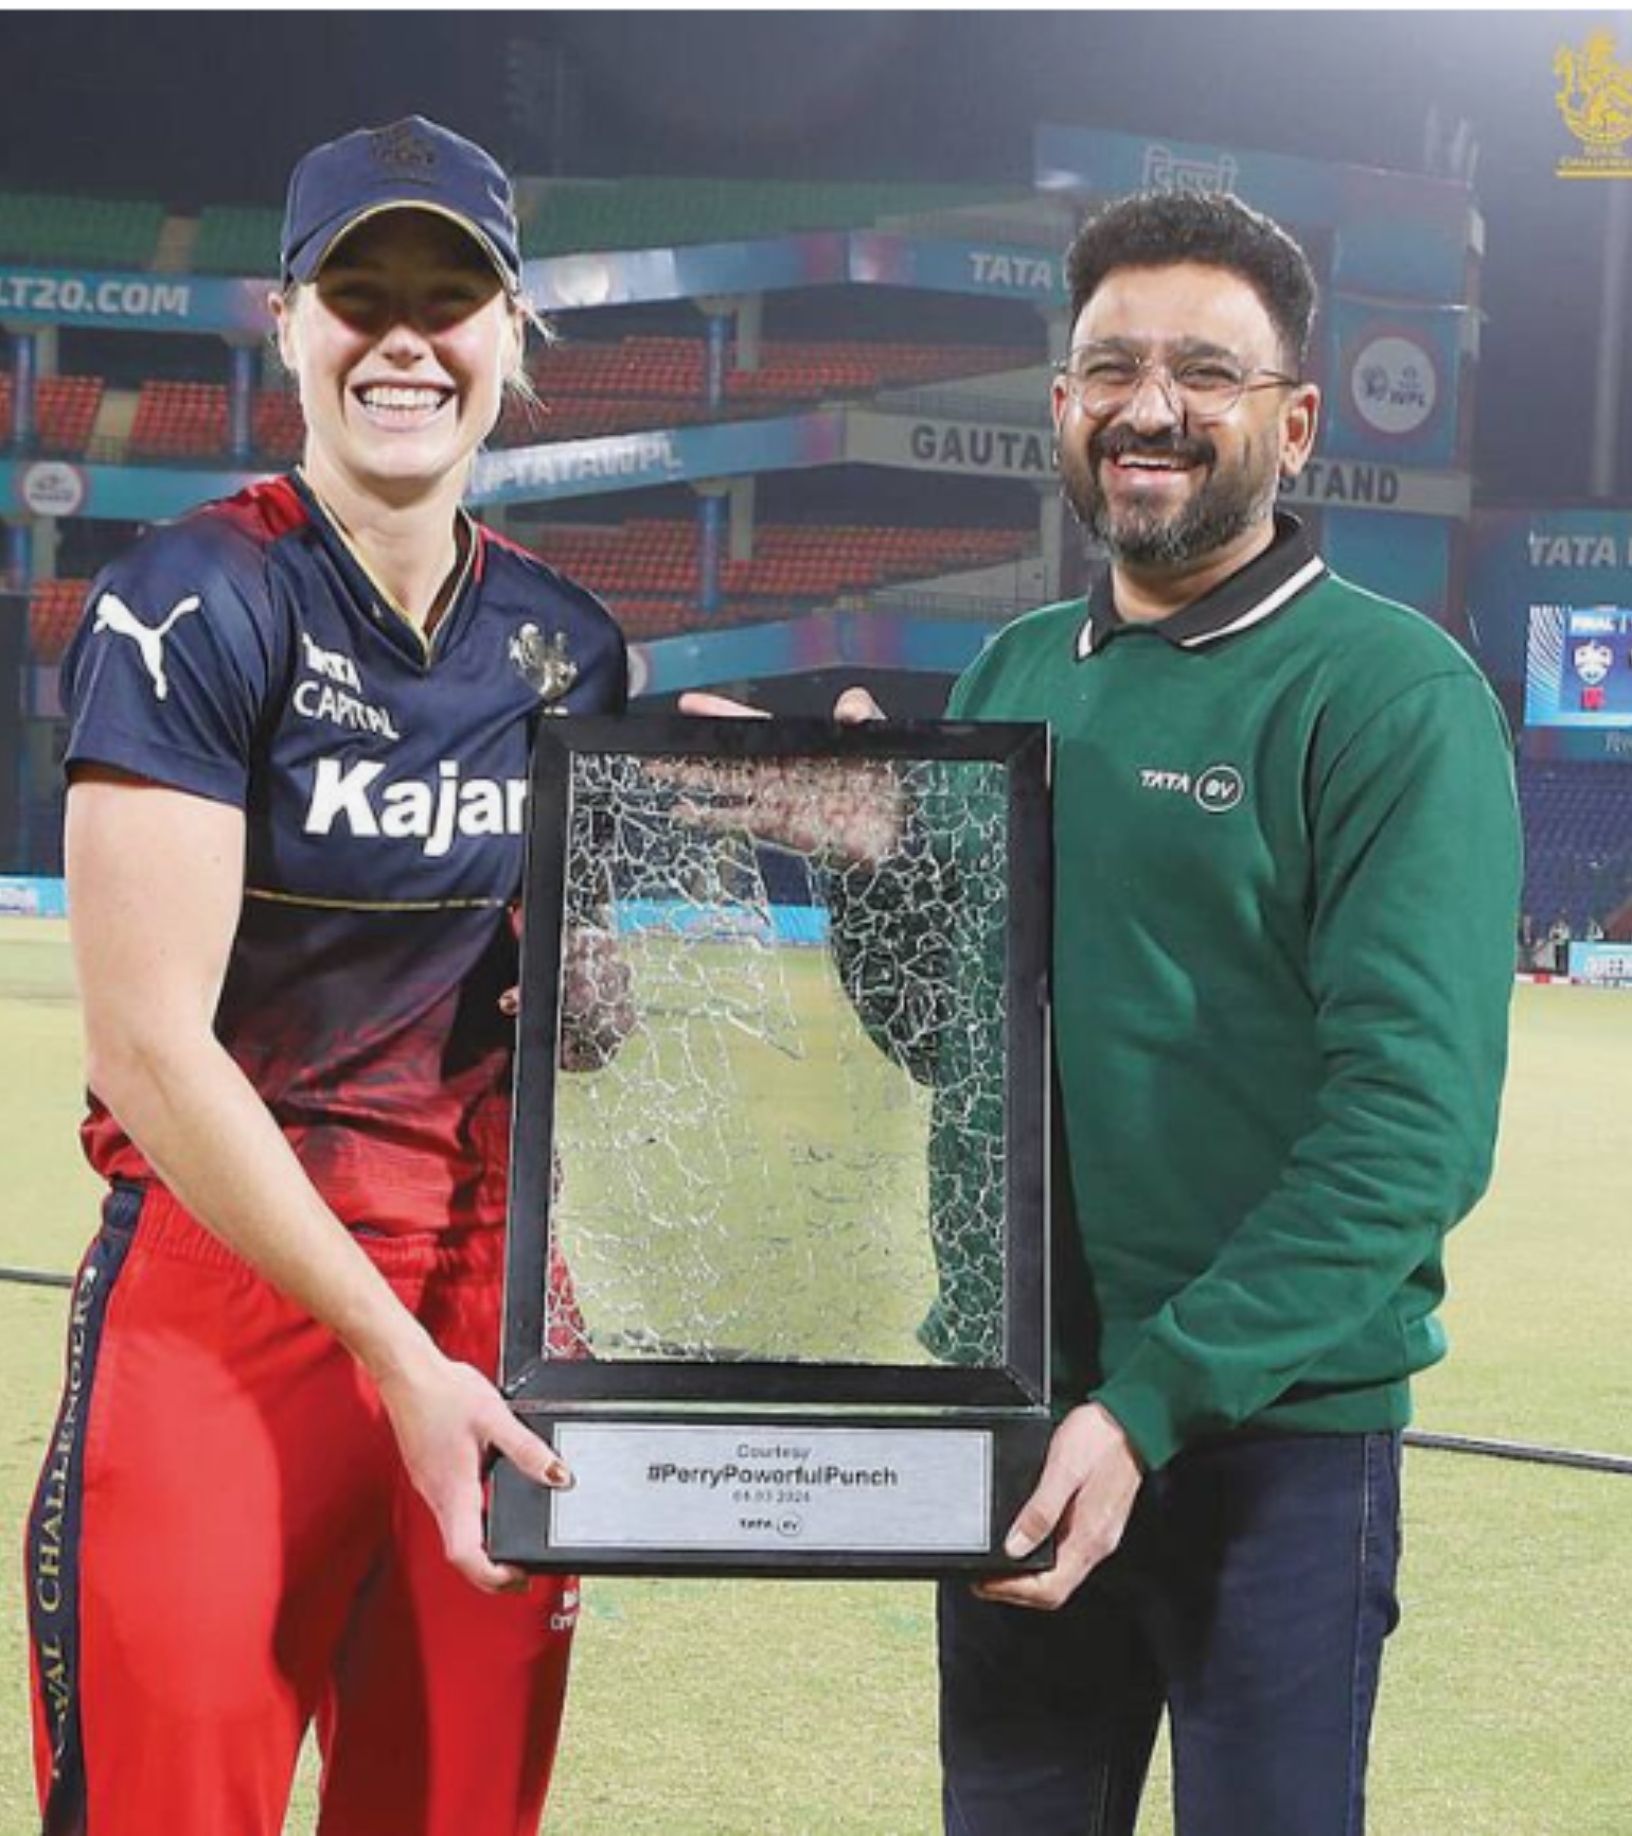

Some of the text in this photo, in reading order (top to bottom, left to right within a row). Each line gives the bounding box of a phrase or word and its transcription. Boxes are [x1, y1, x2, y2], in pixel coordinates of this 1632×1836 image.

[968, 253, 1051, 288] TATA
[910, 423, 1059, 472] GAUTA
[1528, 535, 1617, 567] TATA
[291, 680, 400, 741] CAPITAL
[1139, 768, 1190, 793] TATA
[736, 1443, 812, 1461] Courtesy
[647, 1463, 898, 1489] #PerryPowerfulPunch
